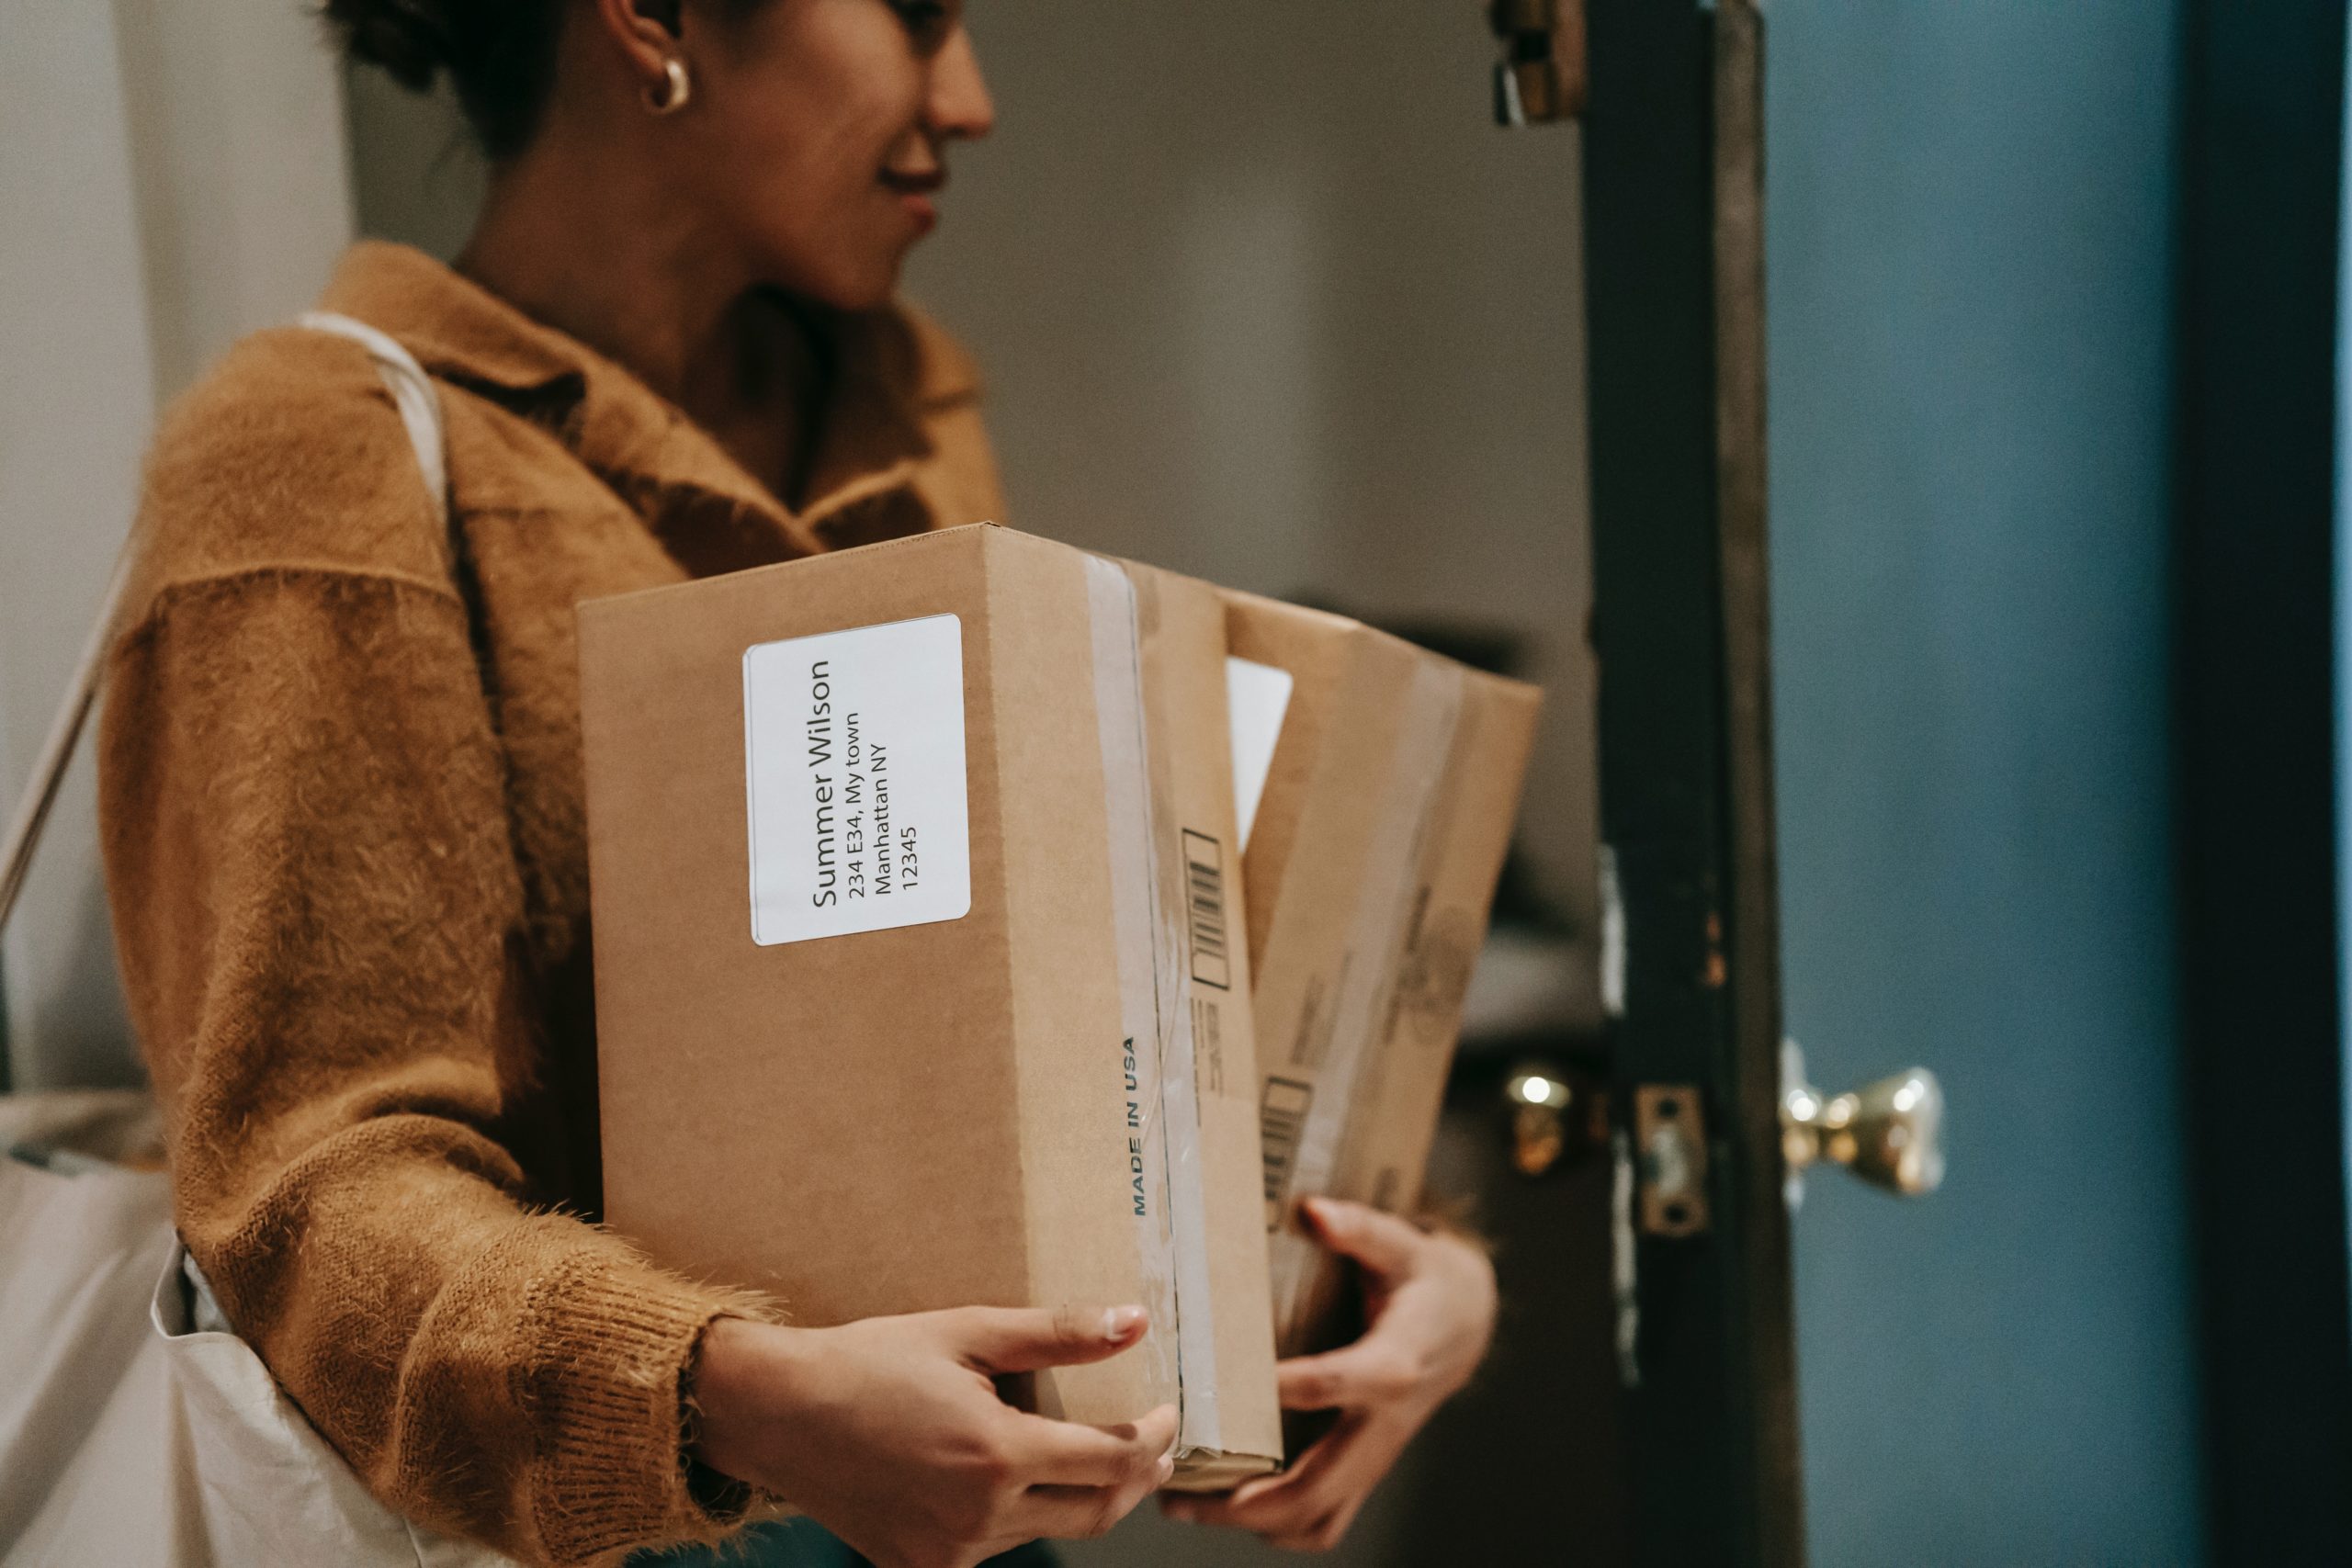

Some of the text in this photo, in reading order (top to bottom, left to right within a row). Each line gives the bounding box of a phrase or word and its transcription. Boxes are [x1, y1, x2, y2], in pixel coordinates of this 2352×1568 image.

[807, 660, 837, 908] Summer Wilson
[845, 712, 865, 899] 234 E34, My town
[870, 743, 891, 895] Manhattan NY
[900, 827, 919, 890] 12345
[1123, 1035, 1147, 1217] MADE IN USA
